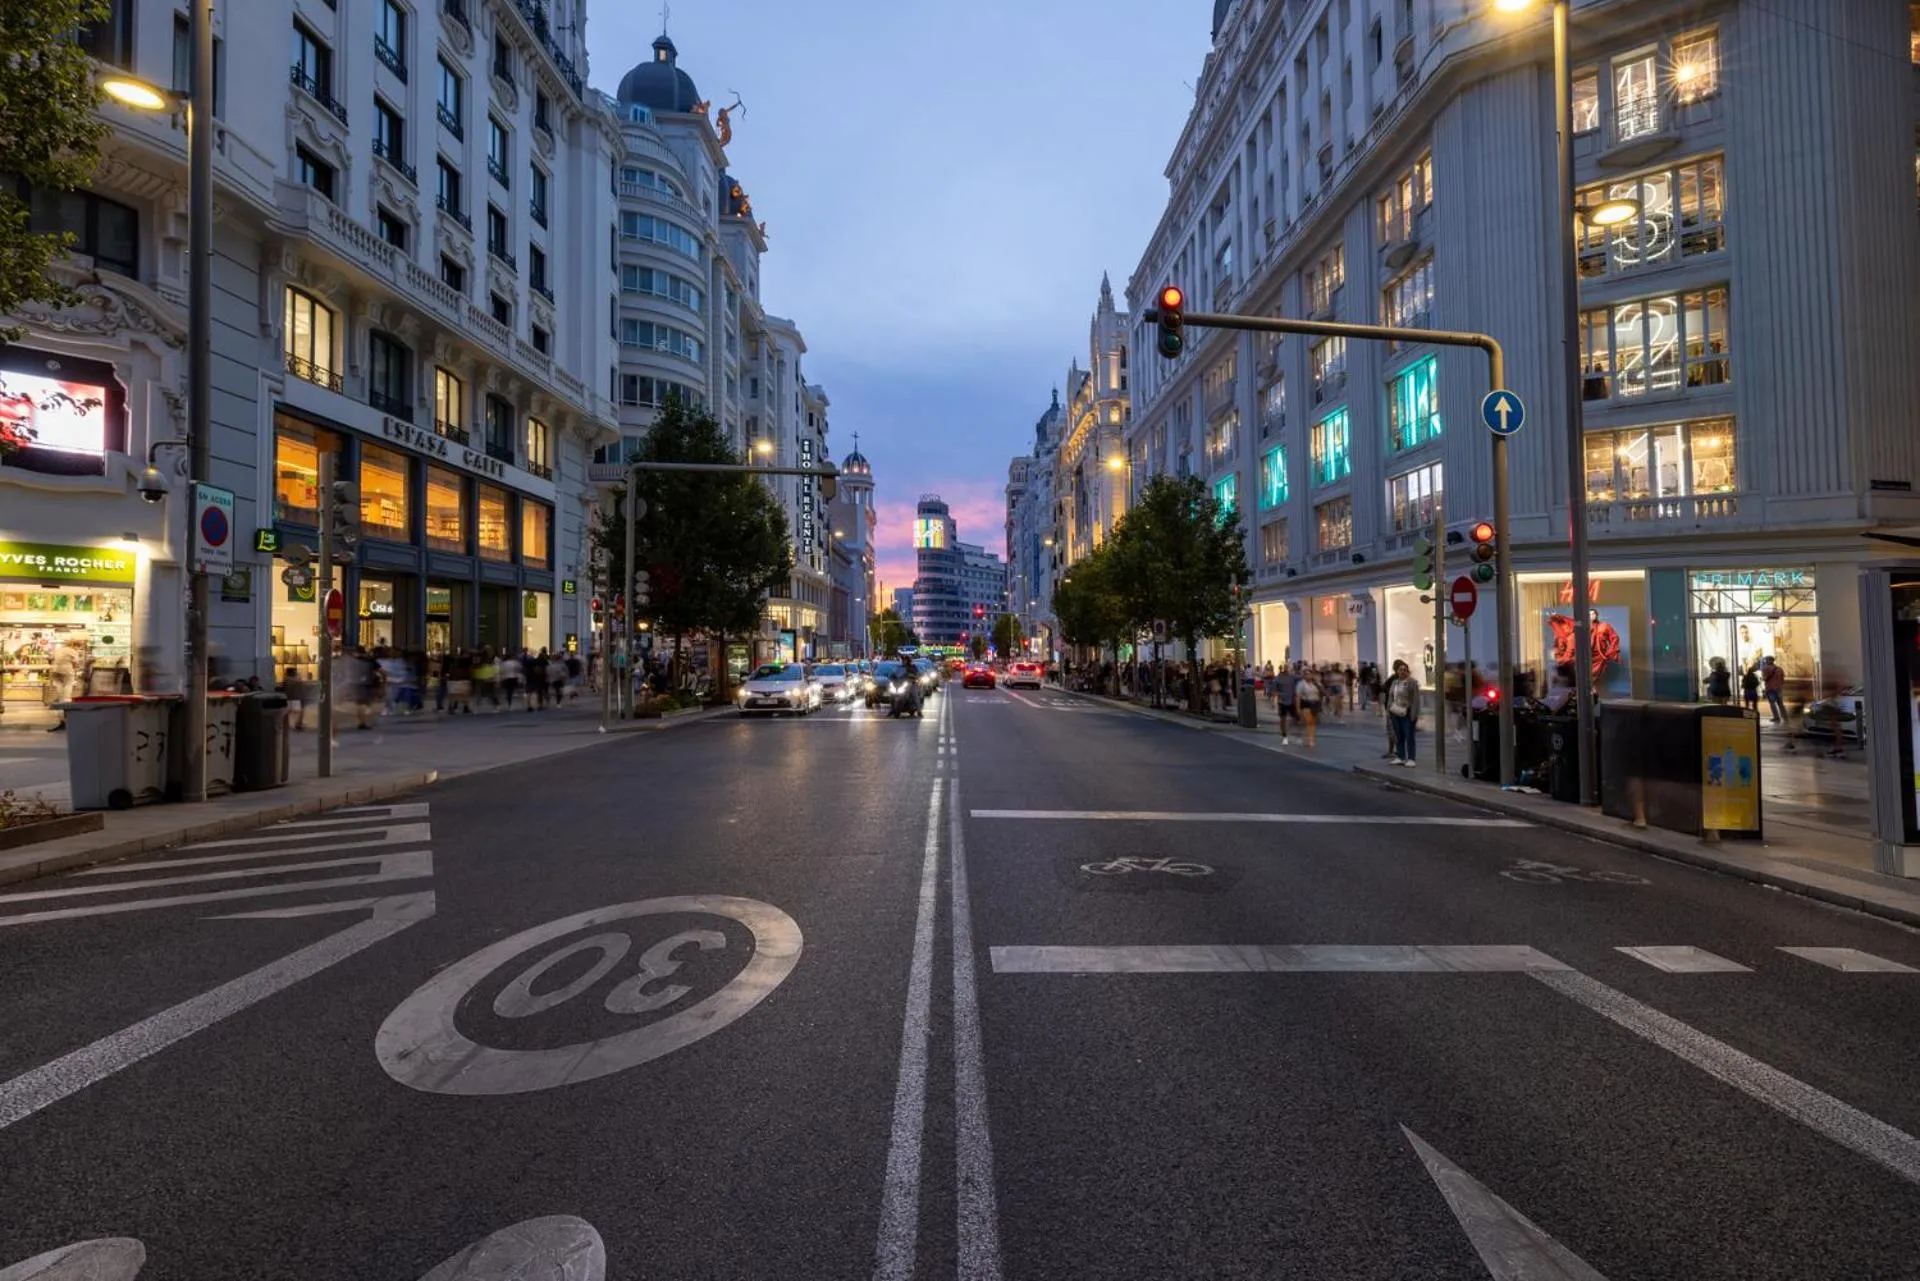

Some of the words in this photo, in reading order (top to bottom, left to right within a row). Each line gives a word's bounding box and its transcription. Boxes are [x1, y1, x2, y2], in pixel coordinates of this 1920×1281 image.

[1614, 297, 1681, 394] 2
[802, 452, 812, 493] HOEL
[0, 553, 46, 565] YVES
[54, 556, 126, 570] ROCHER
[38, 566, 87, 574] FRANCE
[1695, 569, 1805, 587] PRIMARK
[493, 930, 727, 1018] 30
